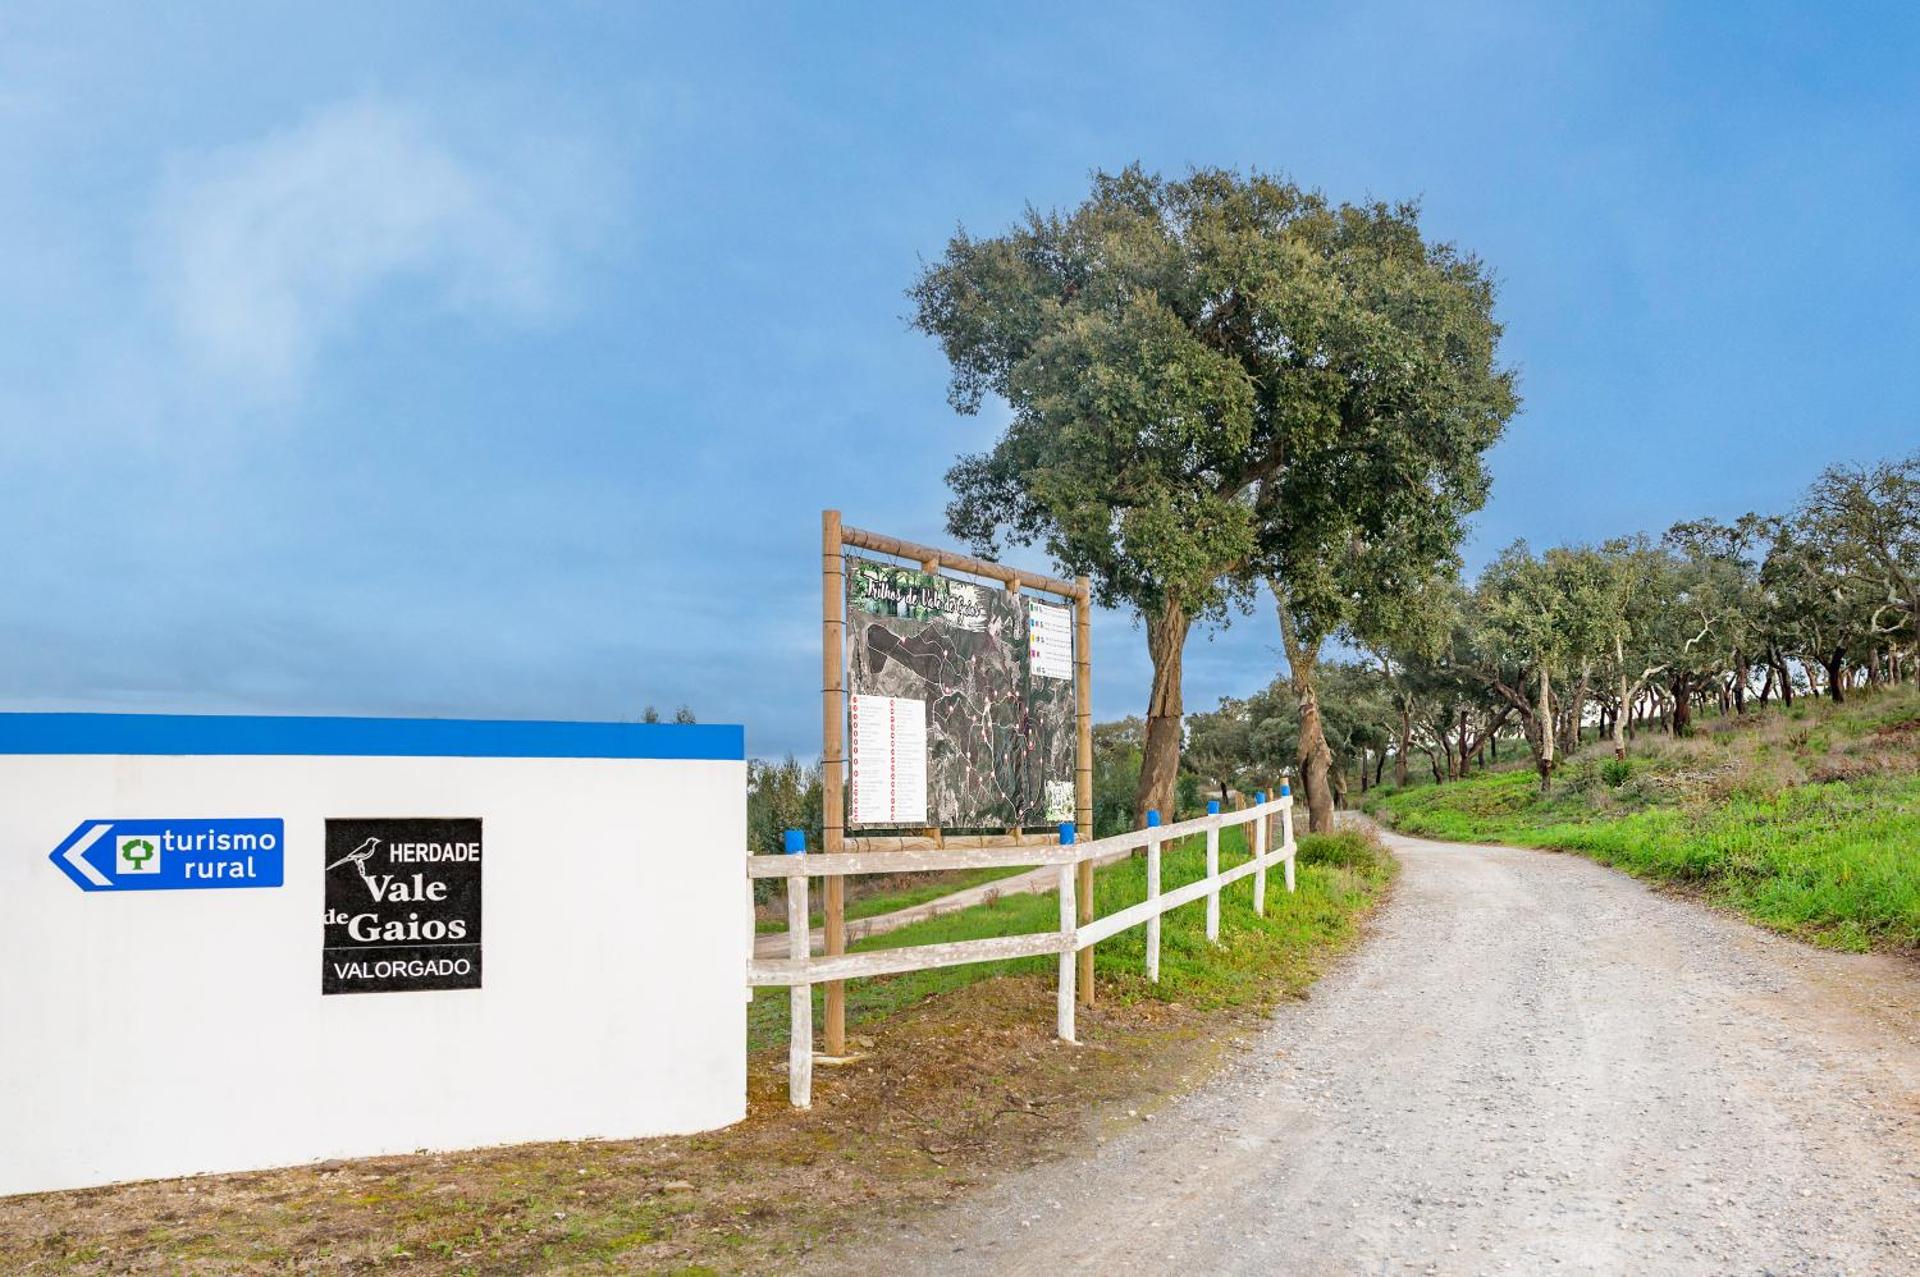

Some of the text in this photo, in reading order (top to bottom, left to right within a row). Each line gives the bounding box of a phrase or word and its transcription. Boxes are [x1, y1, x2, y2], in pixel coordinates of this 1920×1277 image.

[864, 574, 902, 602] Trilhos
[905, 587, 918, 606] de
[922, 588, 942, 610] Vale
[162, 829, 276, 852] turismo
[389, 842, 480, 863] HERDADE
[185, 856, 257, 879] rural
[364, 873, 448, 903] Vale
[323, 907, 466, 942] de Gaios
[333, 958, 471, 980] VALORGADO
